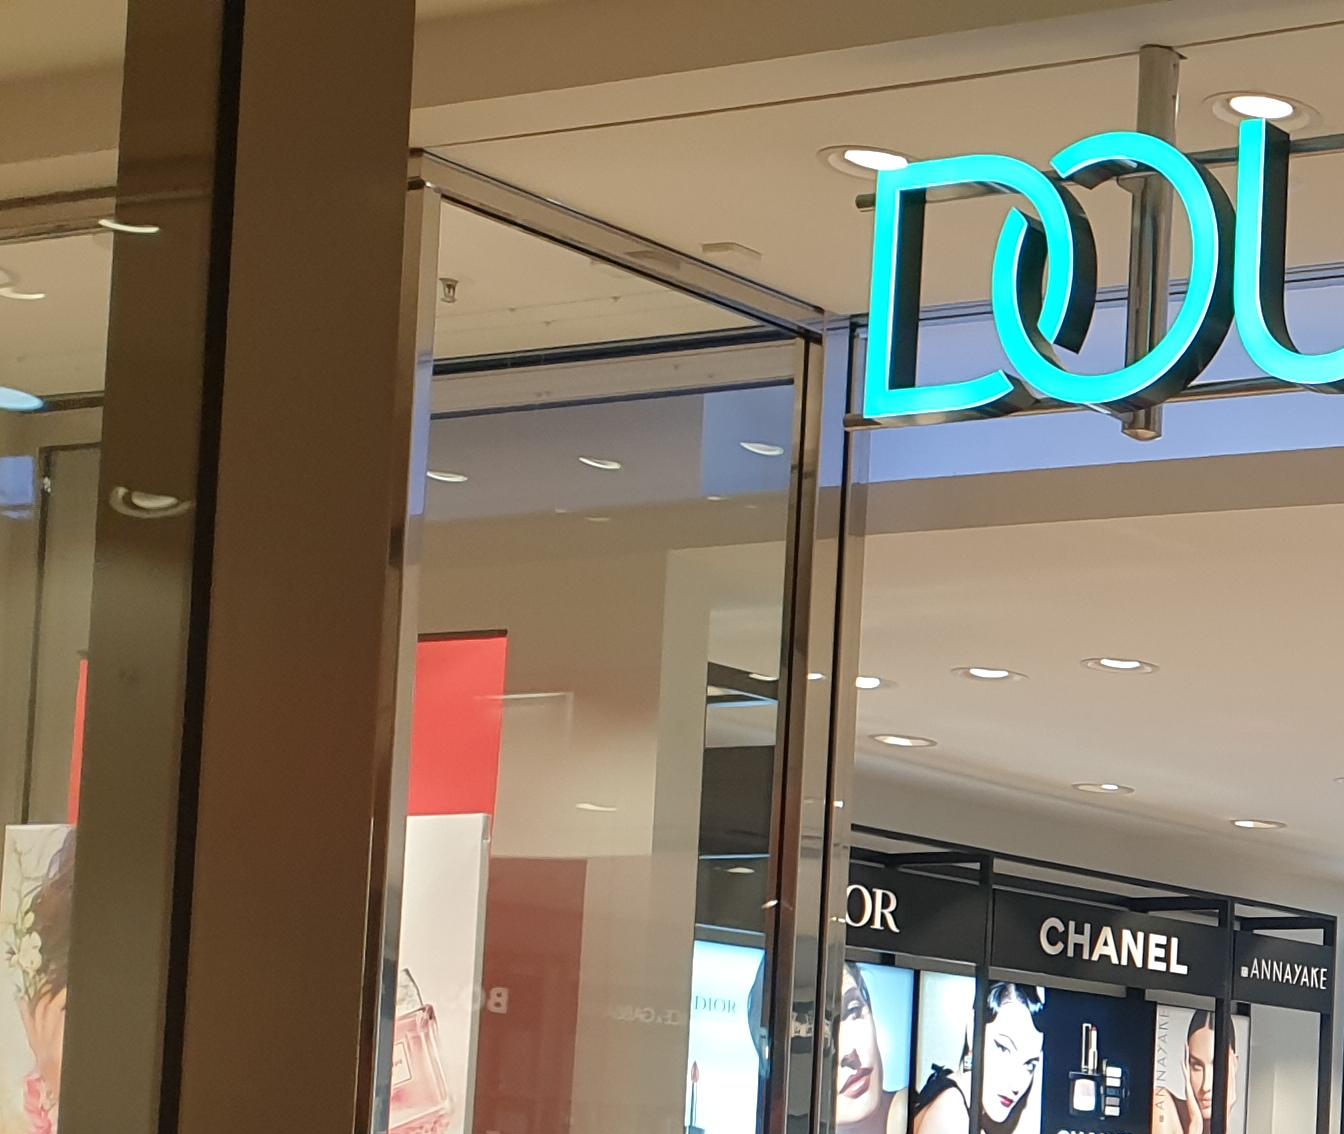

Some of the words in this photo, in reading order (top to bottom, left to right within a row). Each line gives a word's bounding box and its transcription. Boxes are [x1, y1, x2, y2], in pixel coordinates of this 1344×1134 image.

[846, 884, 900, 934] OR
[1039, 917, 1188, 976] CHANEL
[1250, 957, 1328, 990] ANNAYAKE
[695, 995, 736, 1014] DIOR
